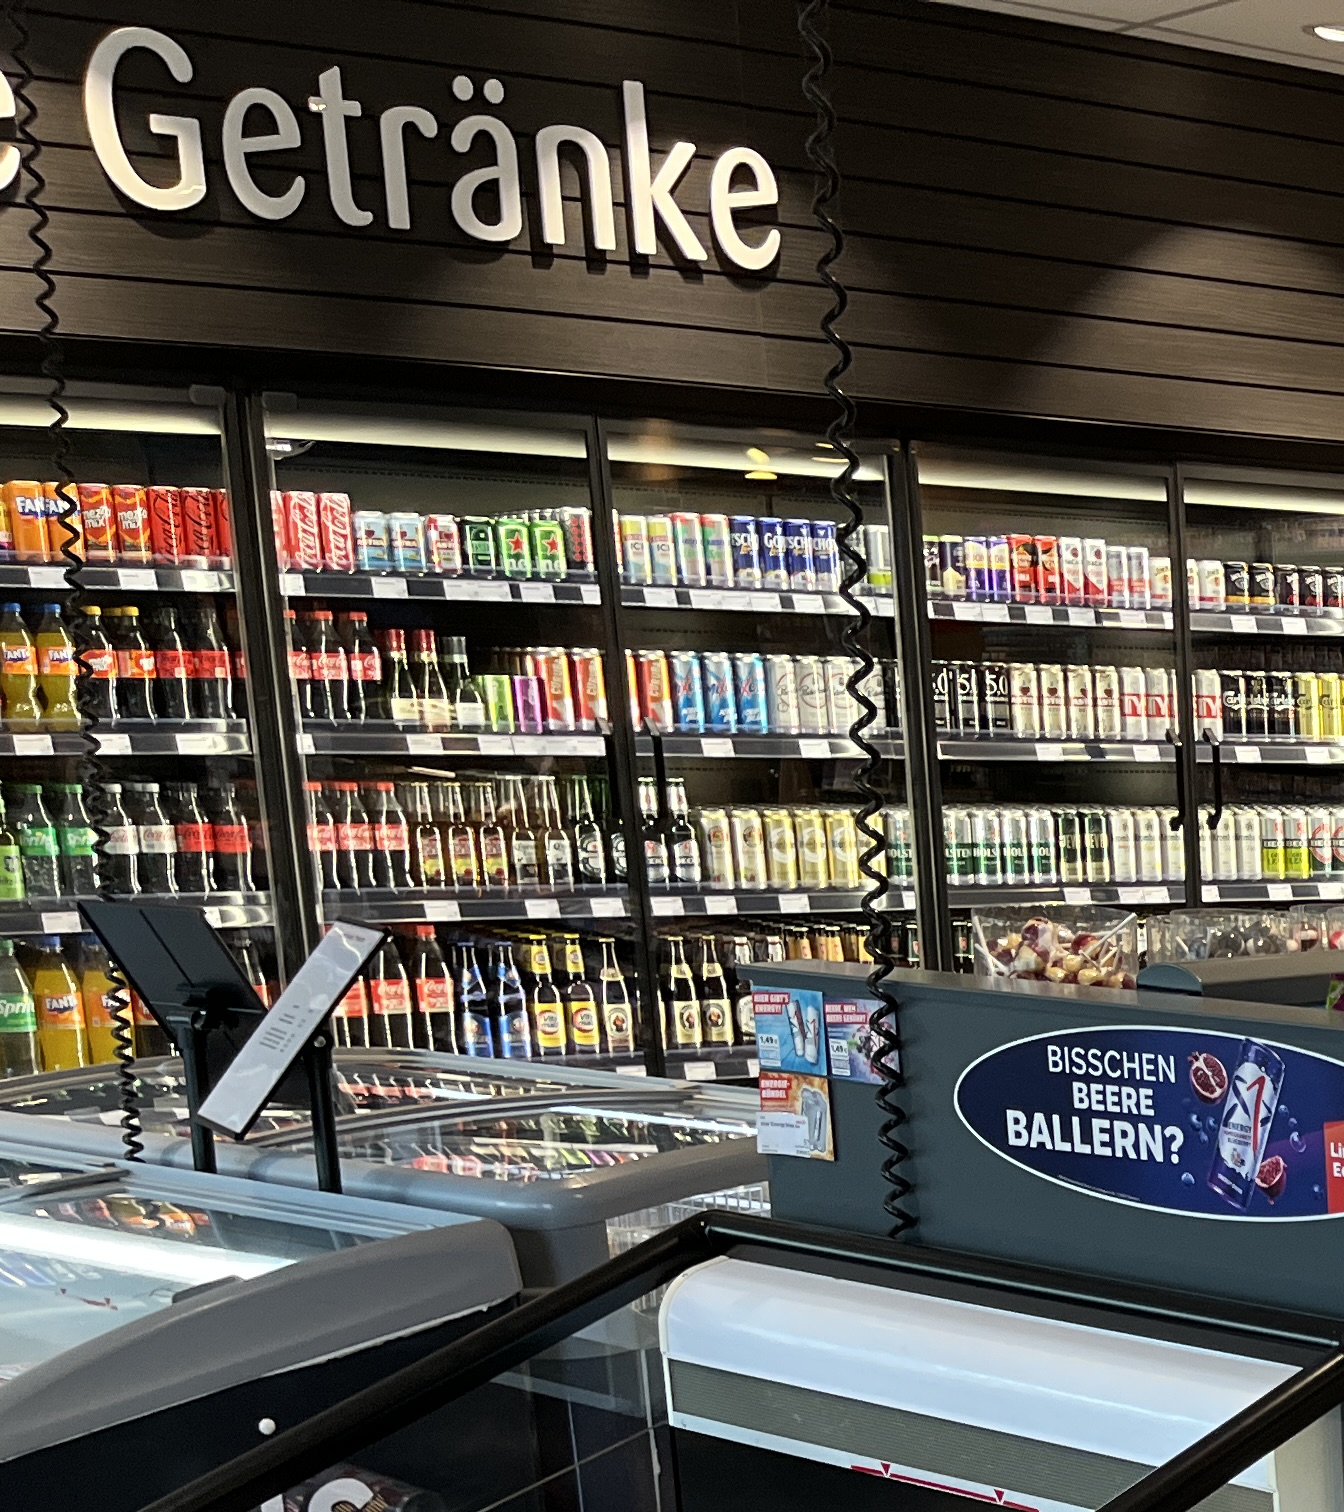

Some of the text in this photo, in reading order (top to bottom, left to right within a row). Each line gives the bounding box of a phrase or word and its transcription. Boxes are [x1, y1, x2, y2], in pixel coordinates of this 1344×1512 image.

[85, 26, 782, 271] Getränke
[1046, 1044, 1176, 1083] BISSCHEN
[1072, 1081, 1156, 1117] BEERE
[1005, 1109, 1185, 1165] BALLERN?
